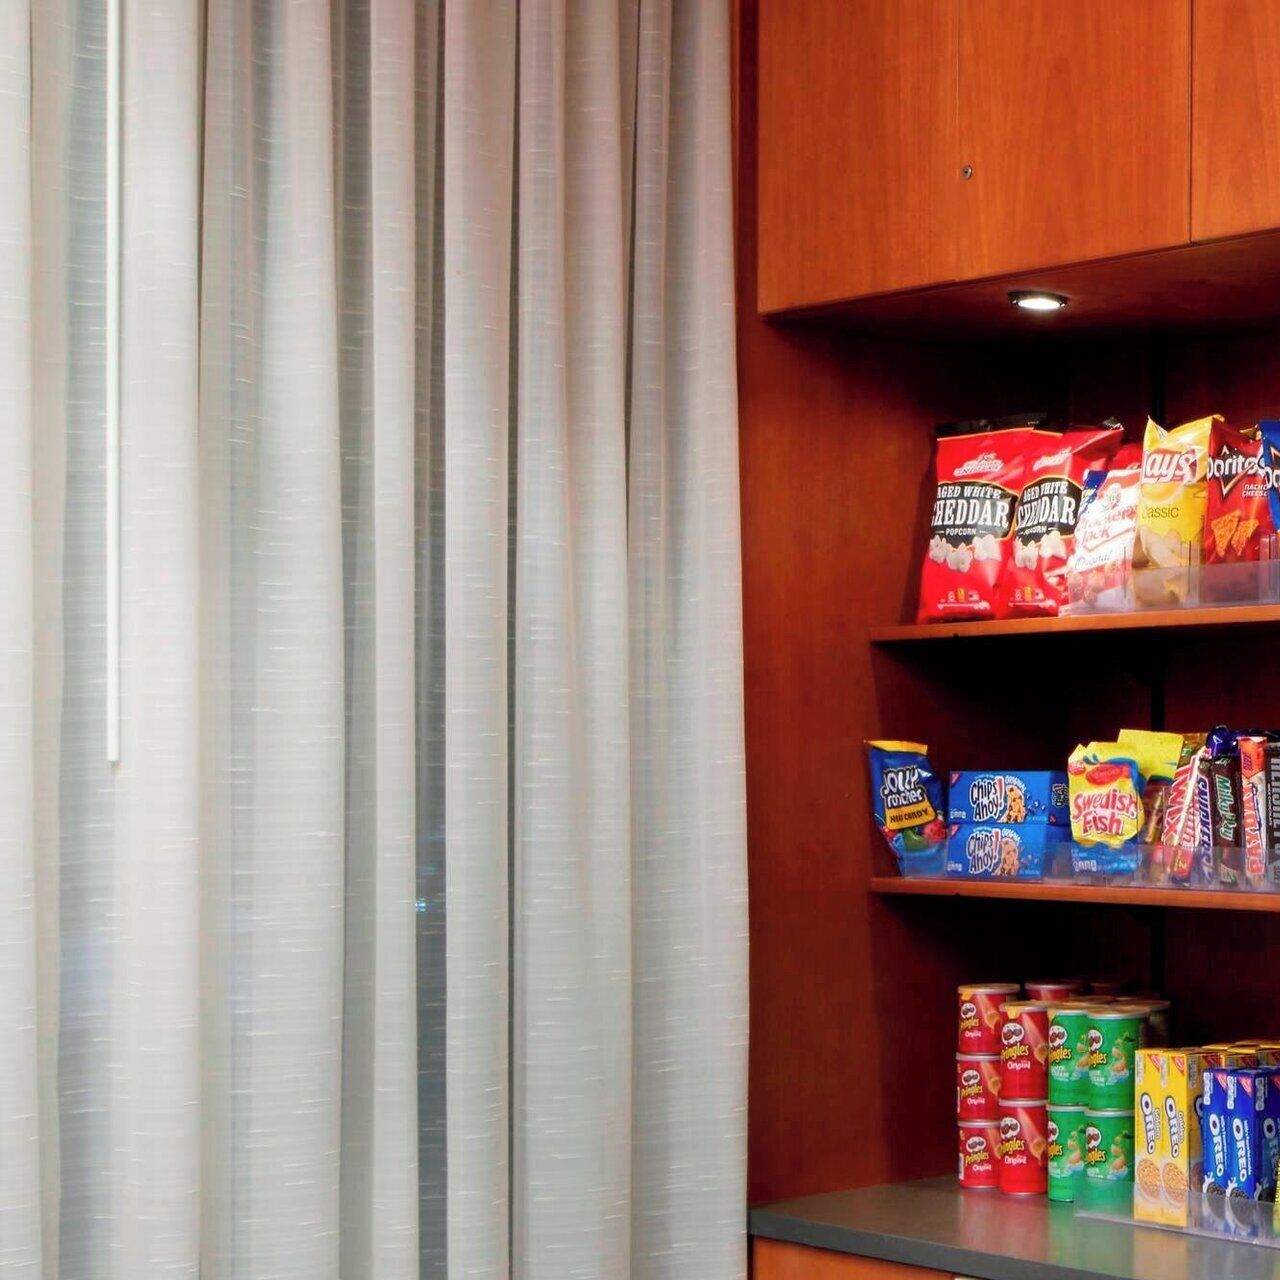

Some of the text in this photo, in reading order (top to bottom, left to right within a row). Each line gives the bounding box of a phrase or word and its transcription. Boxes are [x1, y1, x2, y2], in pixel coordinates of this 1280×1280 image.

[937, 485, 1001, 499] AGED WHITE
[946, 527, 977, 536] POPCORN
[970, 778, 998, 804] Chips
[1072, 789, 1137, 822] Swedish
[1216, 775, 1234, 814] Milky
[1082, 811, 1123, 835] Fish
[1007, 1060, 1031, 1071] Original
[1140, 1092, 1156, 1155] OREO
[1165, 1095, 1180, 1159] OREO
[1004, 1154, 1028, 1165] Original
[1208, 1113, 1224, 1177] OREO
[1232, 1118, 1247, 1182] OREO
